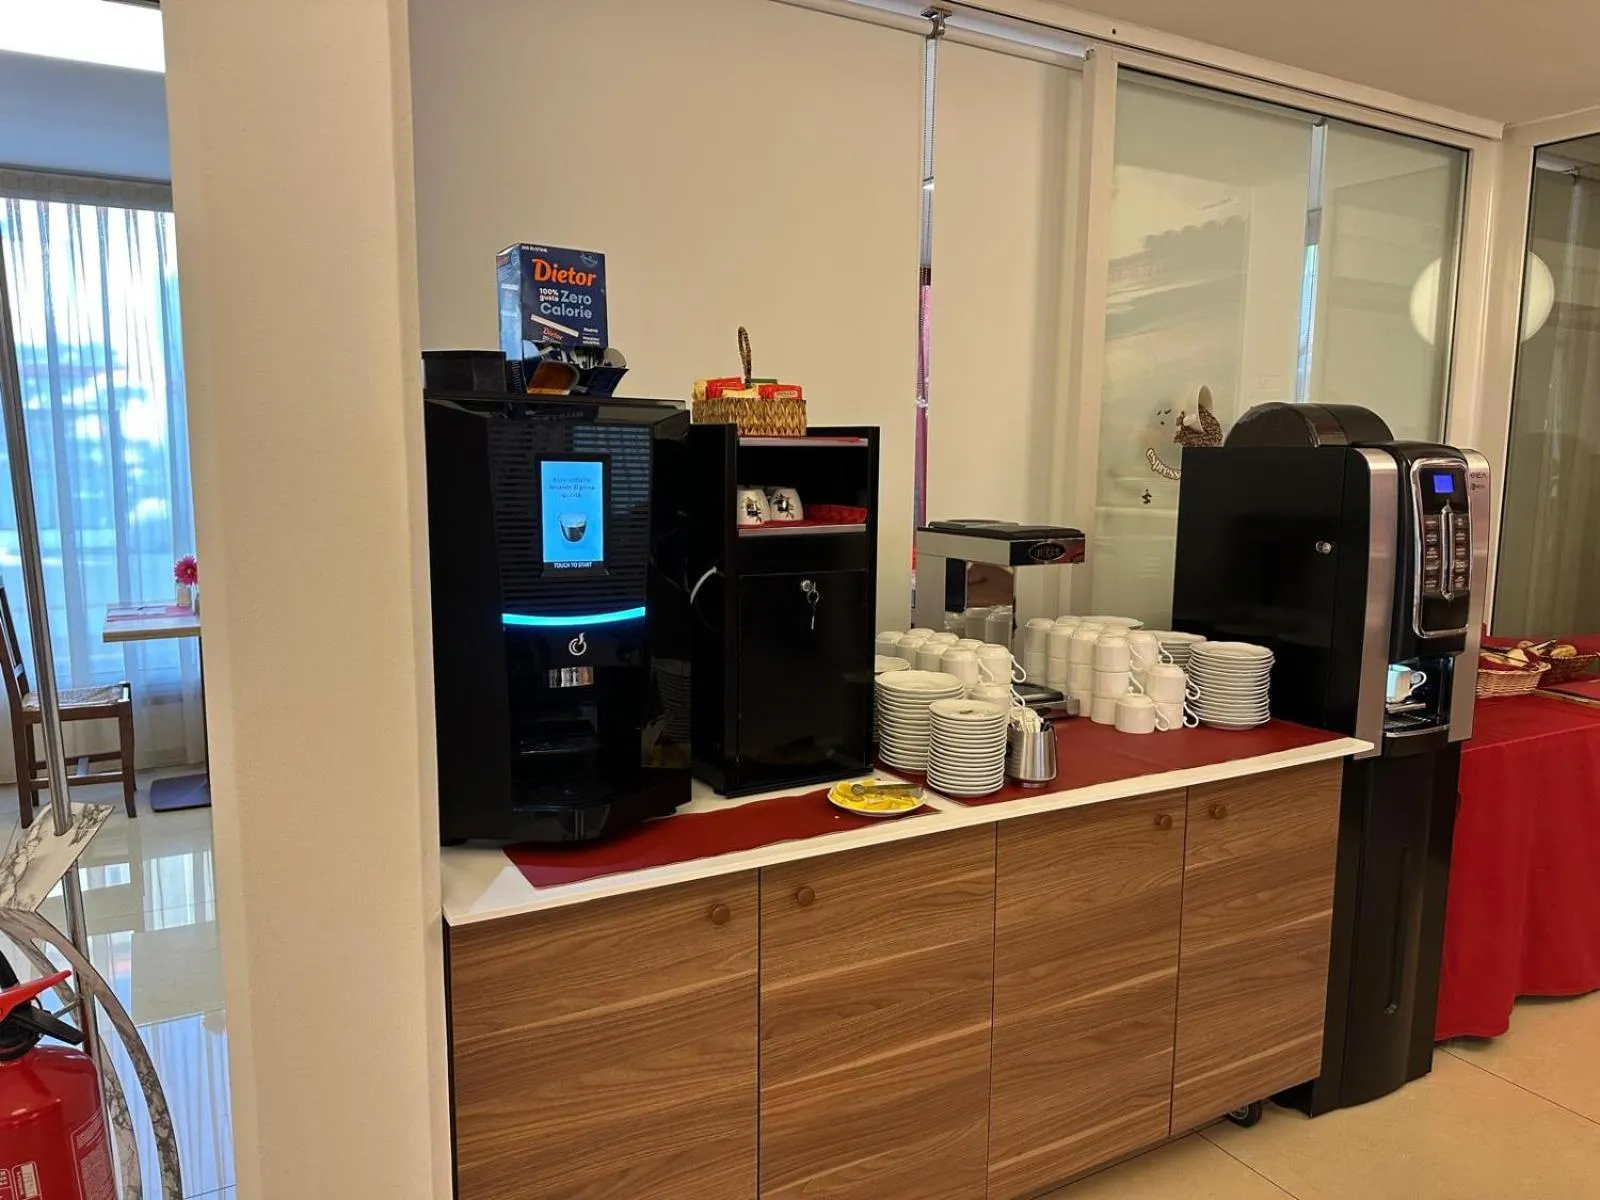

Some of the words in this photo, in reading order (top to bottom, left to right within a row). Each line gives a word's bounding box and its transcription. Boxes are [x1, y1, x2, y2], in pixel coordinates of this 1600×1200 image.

[532, 258, 596, 286] Dietor
[560, 289, 592, 304] Zero
[540, 303, 592, 319] Calorie
[1146, 447, 1180, 480] espress
